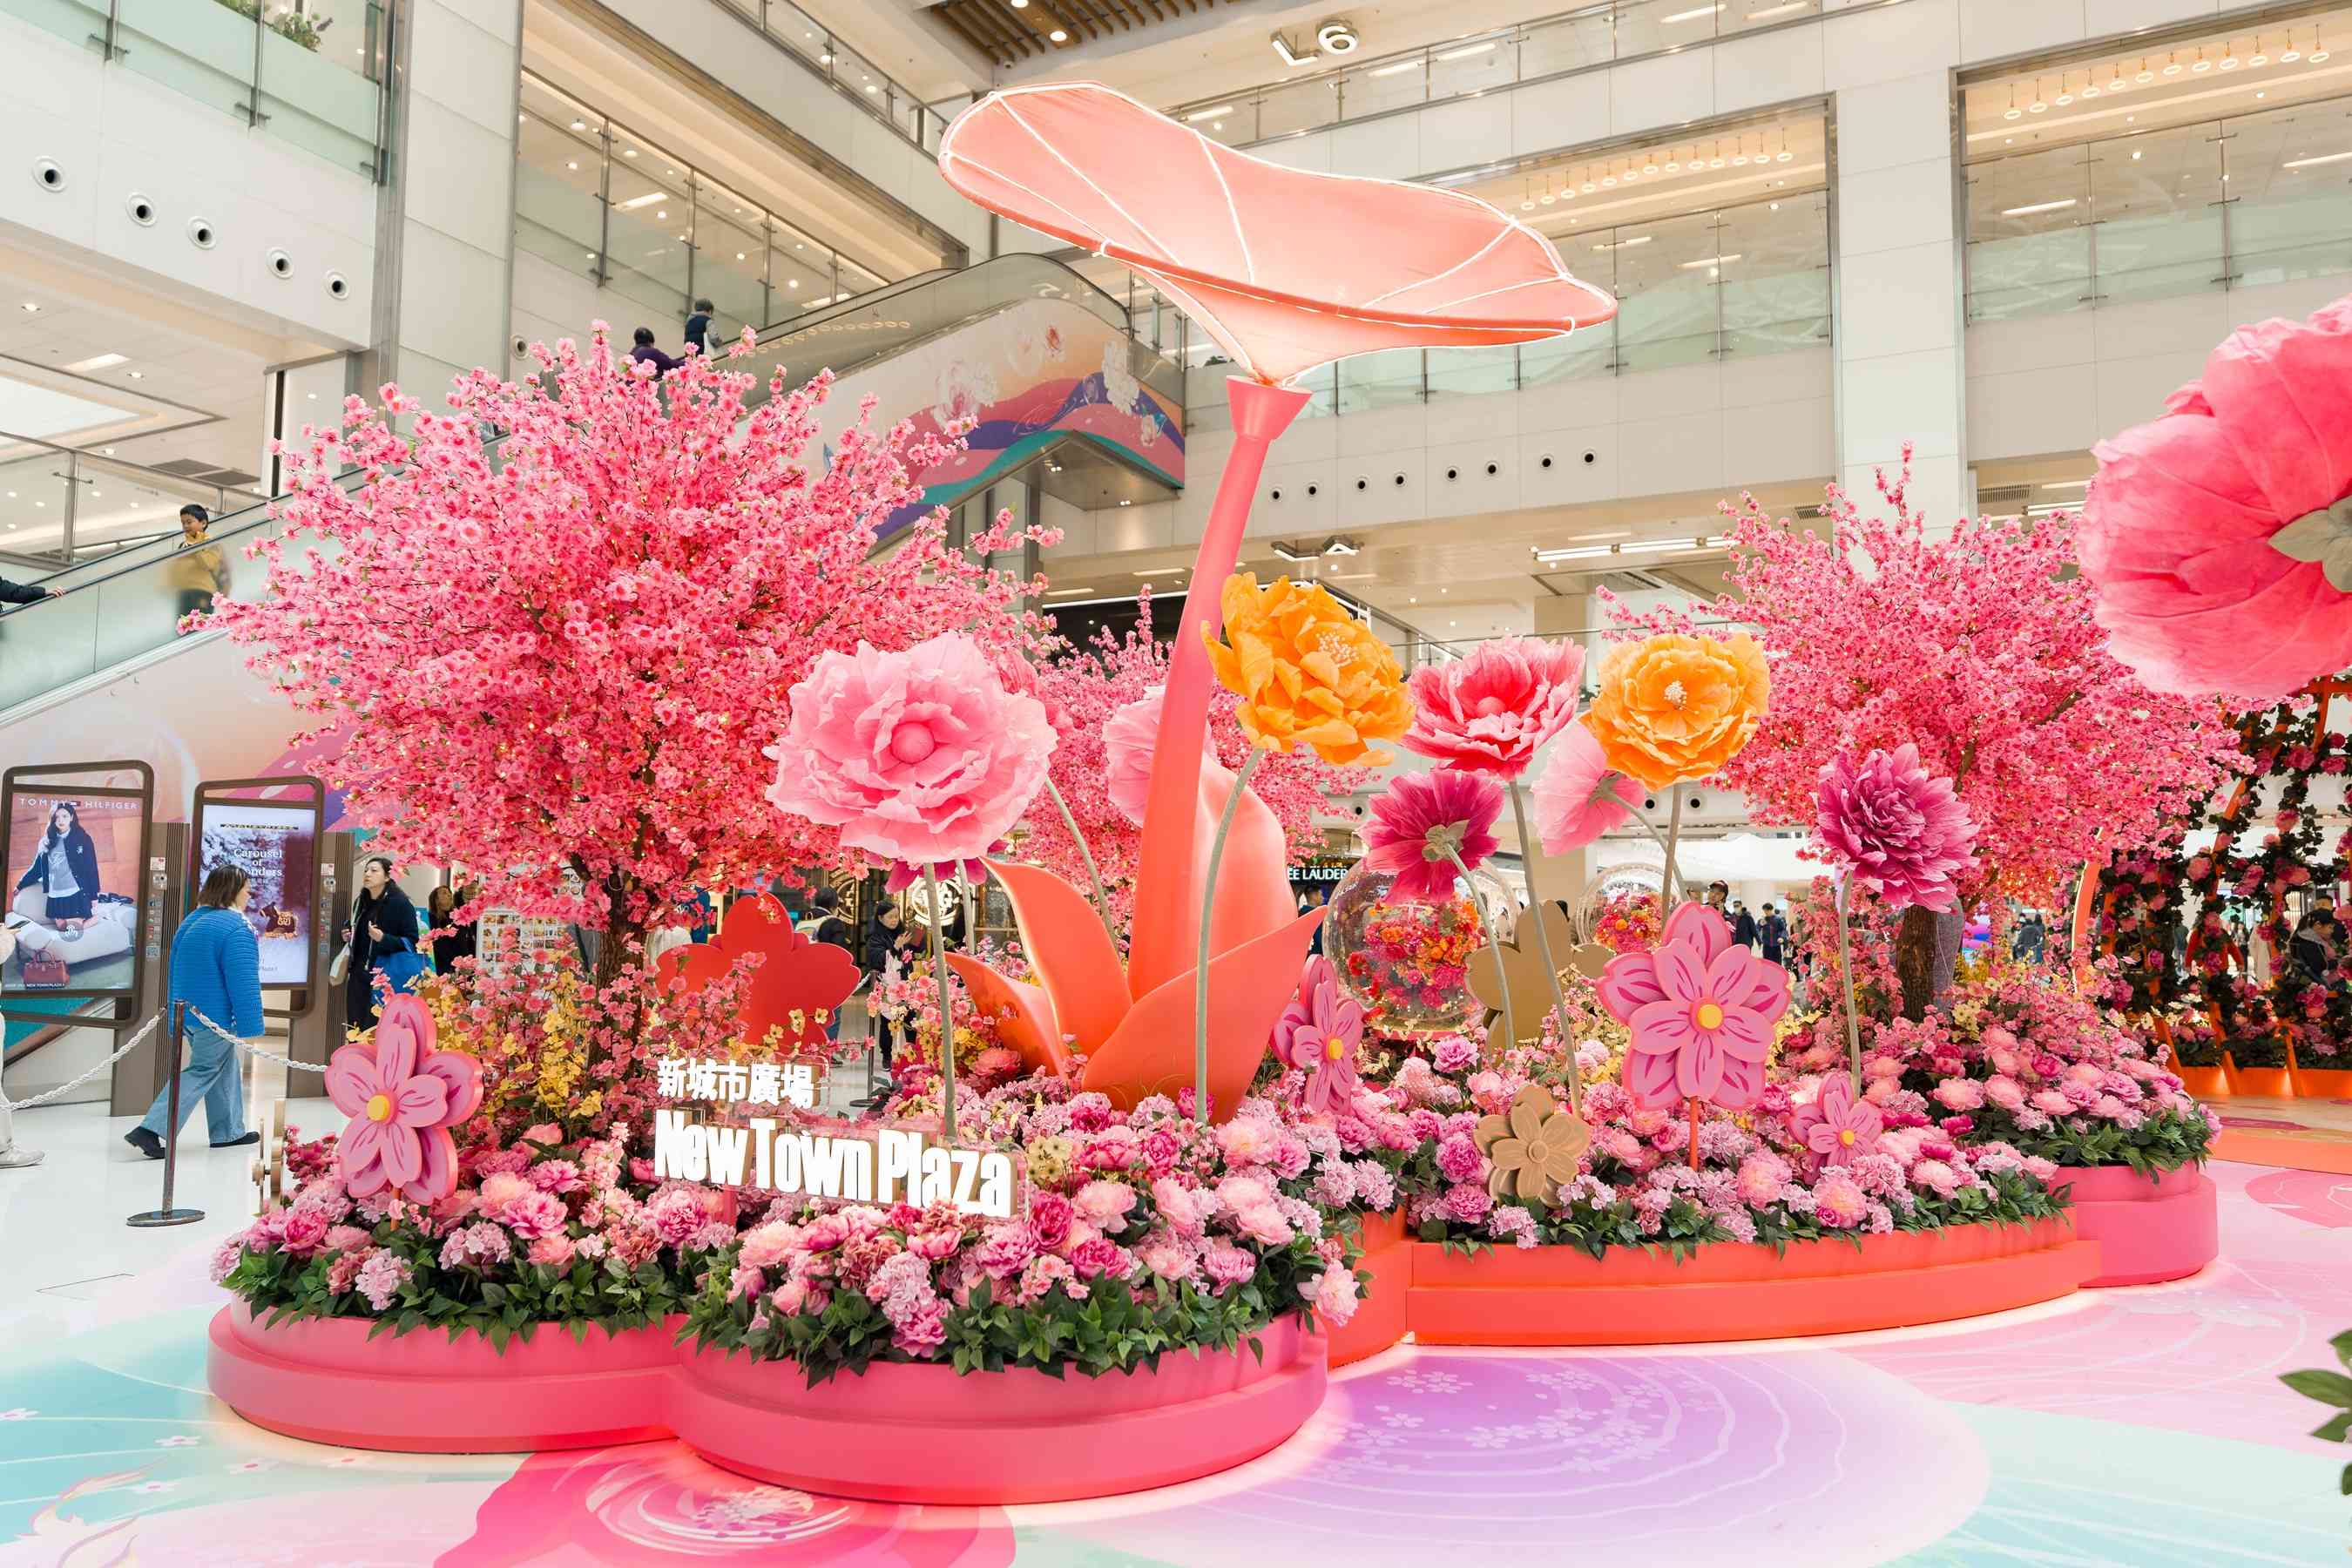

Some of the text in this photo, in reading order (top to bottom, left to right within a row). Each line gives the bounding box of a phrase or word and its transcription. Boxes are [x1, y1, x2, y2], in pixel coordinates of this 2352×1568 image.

[19, 798, 139, 810] TOMMY HILFIGER
[233, 848, 283, 859] Carousel
[246, 867, 283, 877] onders
[656, 1055, 815, 1110] 新城市廣場
[654, 1108, 1012, 1219] New Town Plaza
